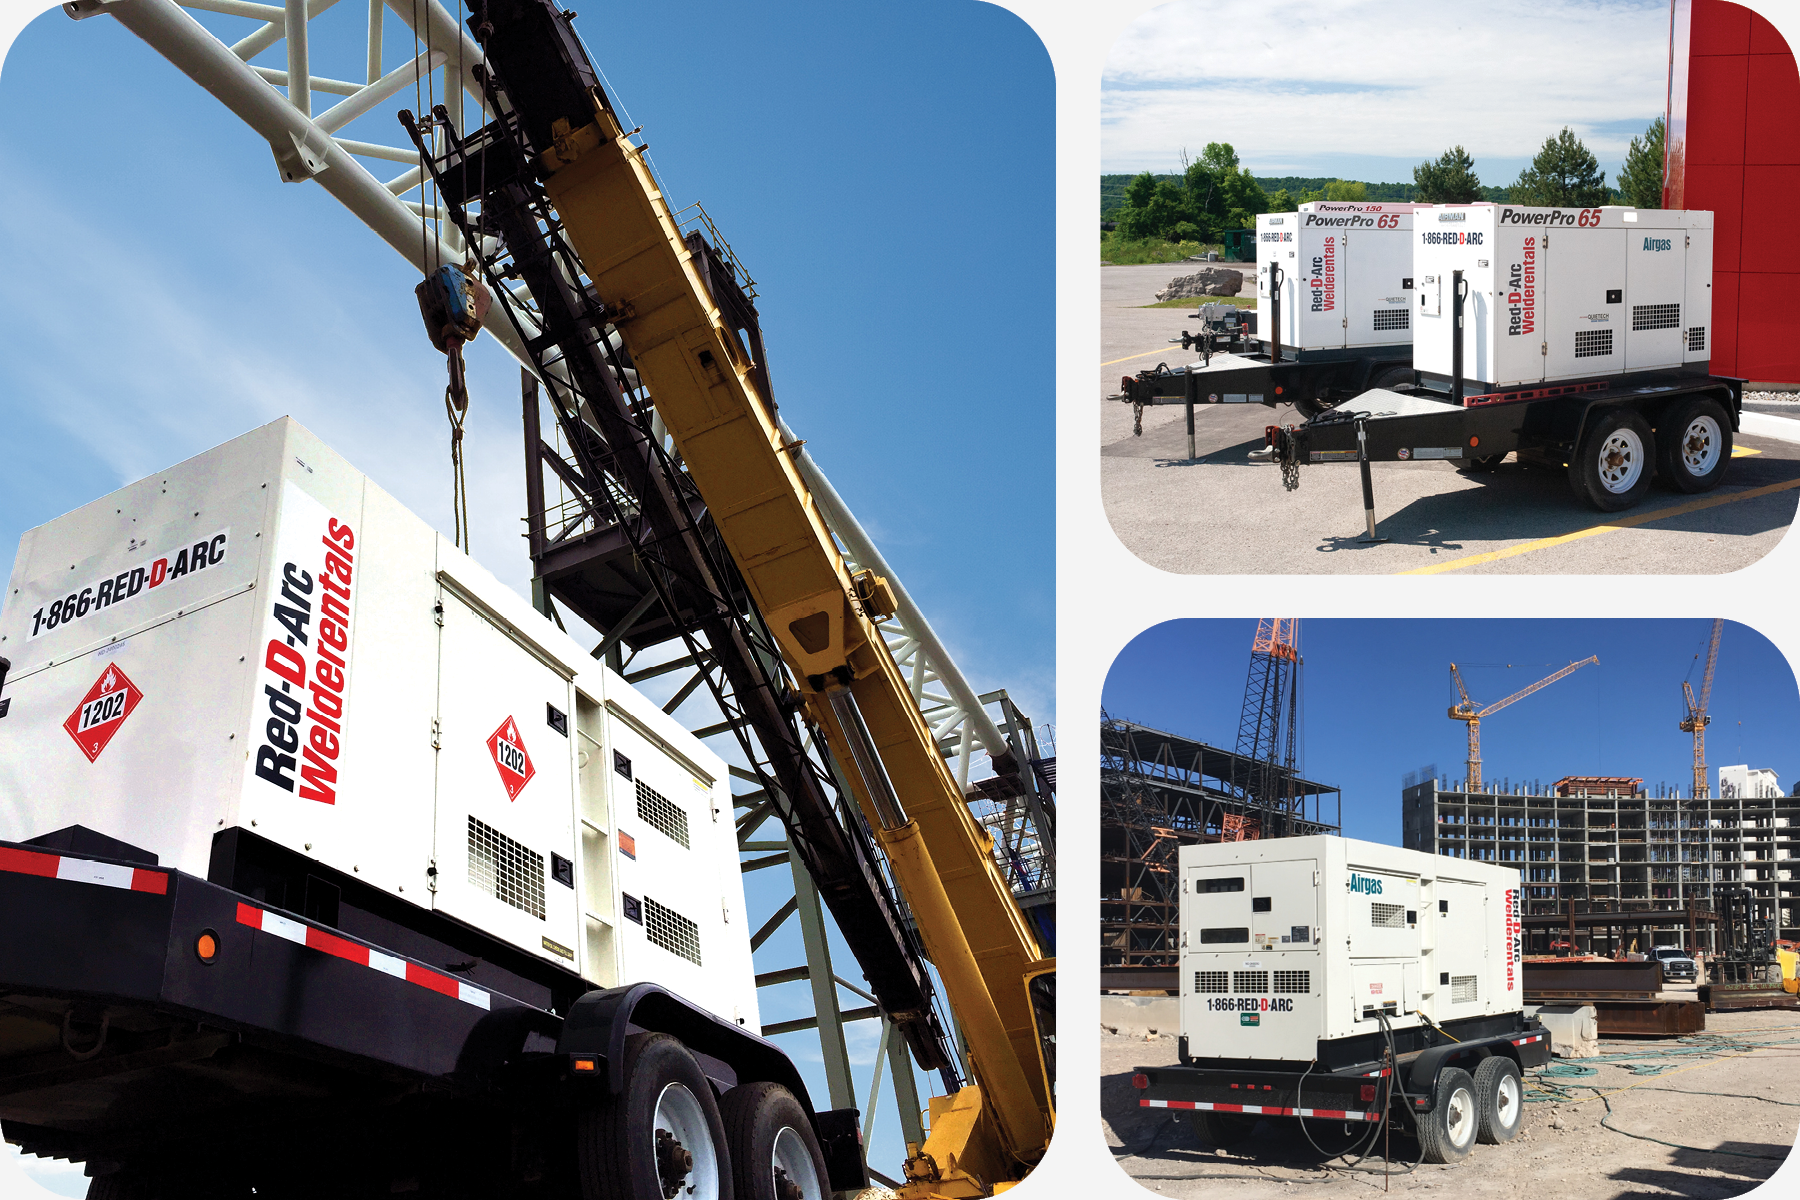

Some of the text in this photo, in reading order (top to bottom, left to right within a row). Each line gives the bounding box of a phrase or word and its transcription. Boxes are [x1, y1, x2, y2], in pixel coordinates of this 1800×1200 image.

[1305, 213, 1400, 229] PowerPro 65
[1319, 204, 1363, 212] PowerPro
[1500, 208, 1603, 227] PowerPro 65
[1643, 236, 1672, 252] Airgas
[1310, 256, 1323, 312] Red-D-Arc
[1323, 236, 1335, 312] Welderentals
[1522, 236, 1535, 336] Welderentals
[1508, 263, 1522, 336] Red-D-Arc
[32, 533, 226, 637] 1-866-RED-D-ARC
[255, 561, 314, 793] Red-D-Arc
[298, 517, 355, 806] Welderentals
[83, 692, 125, 729] 1202
[92, 742, 99, 754] 3
[498, 740, 525, 775] 1202
[510, 784, 514, 794] 3
[1350, 872, 1383, 896] Airgas
[1505, 889, 1514, 992] Welderentals
[1512, 889, 1521, 963] Red-D-Arc
